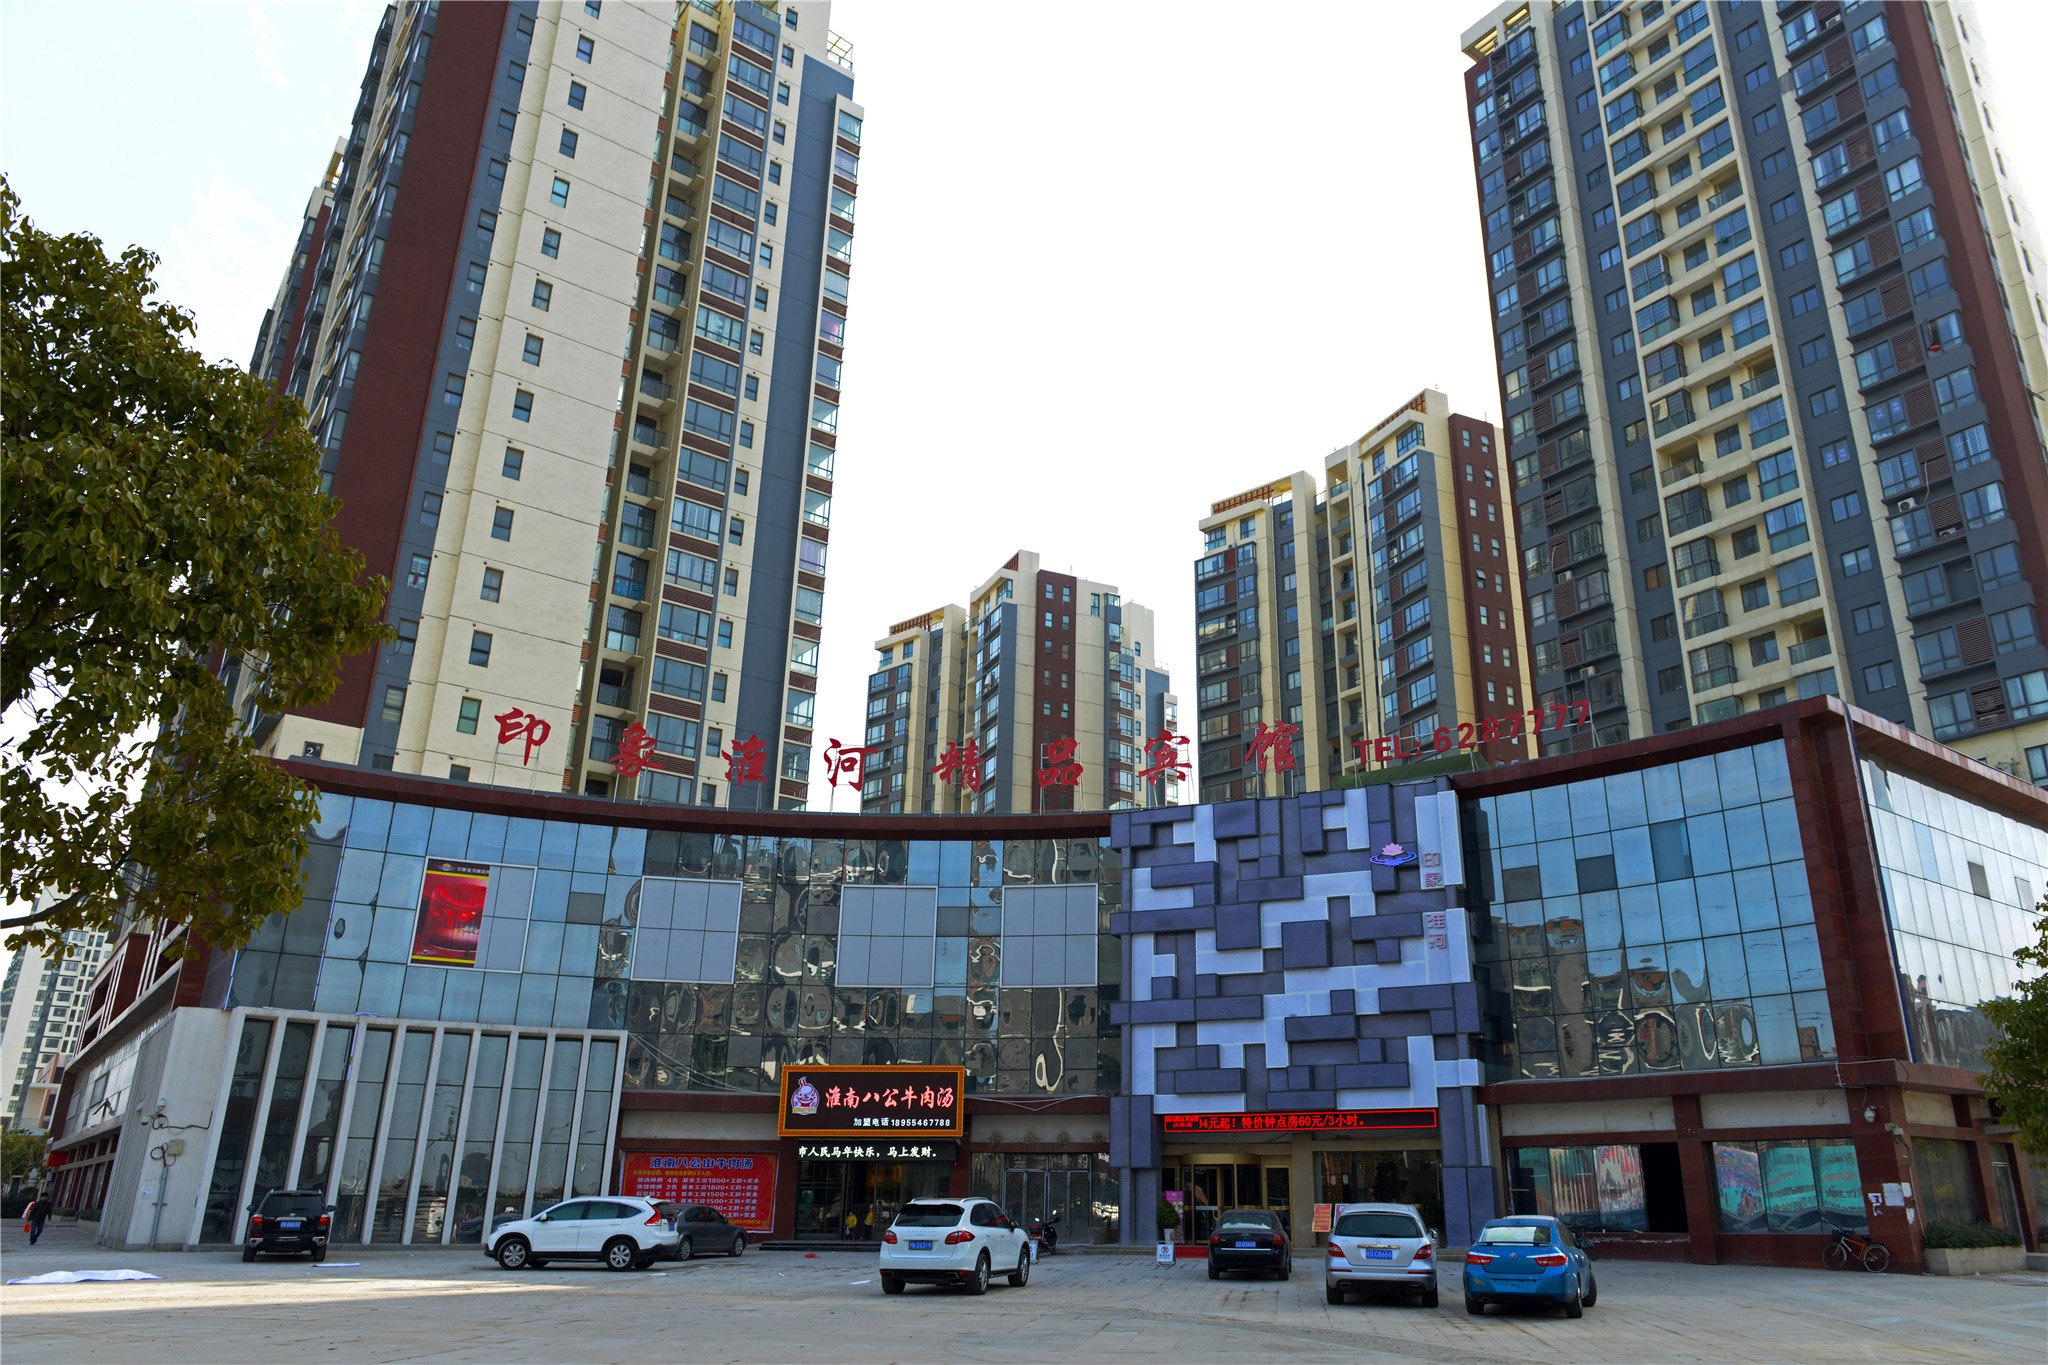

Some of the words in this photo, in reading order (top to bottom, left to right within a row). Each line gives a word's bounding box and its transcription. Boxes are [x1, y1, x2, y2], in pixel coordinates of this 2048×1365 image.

[825, 1085, 954, 1109] 淮南八公牛肉汤
[650, 1157, 753, 1169] 淮南八公山牛肉汤
